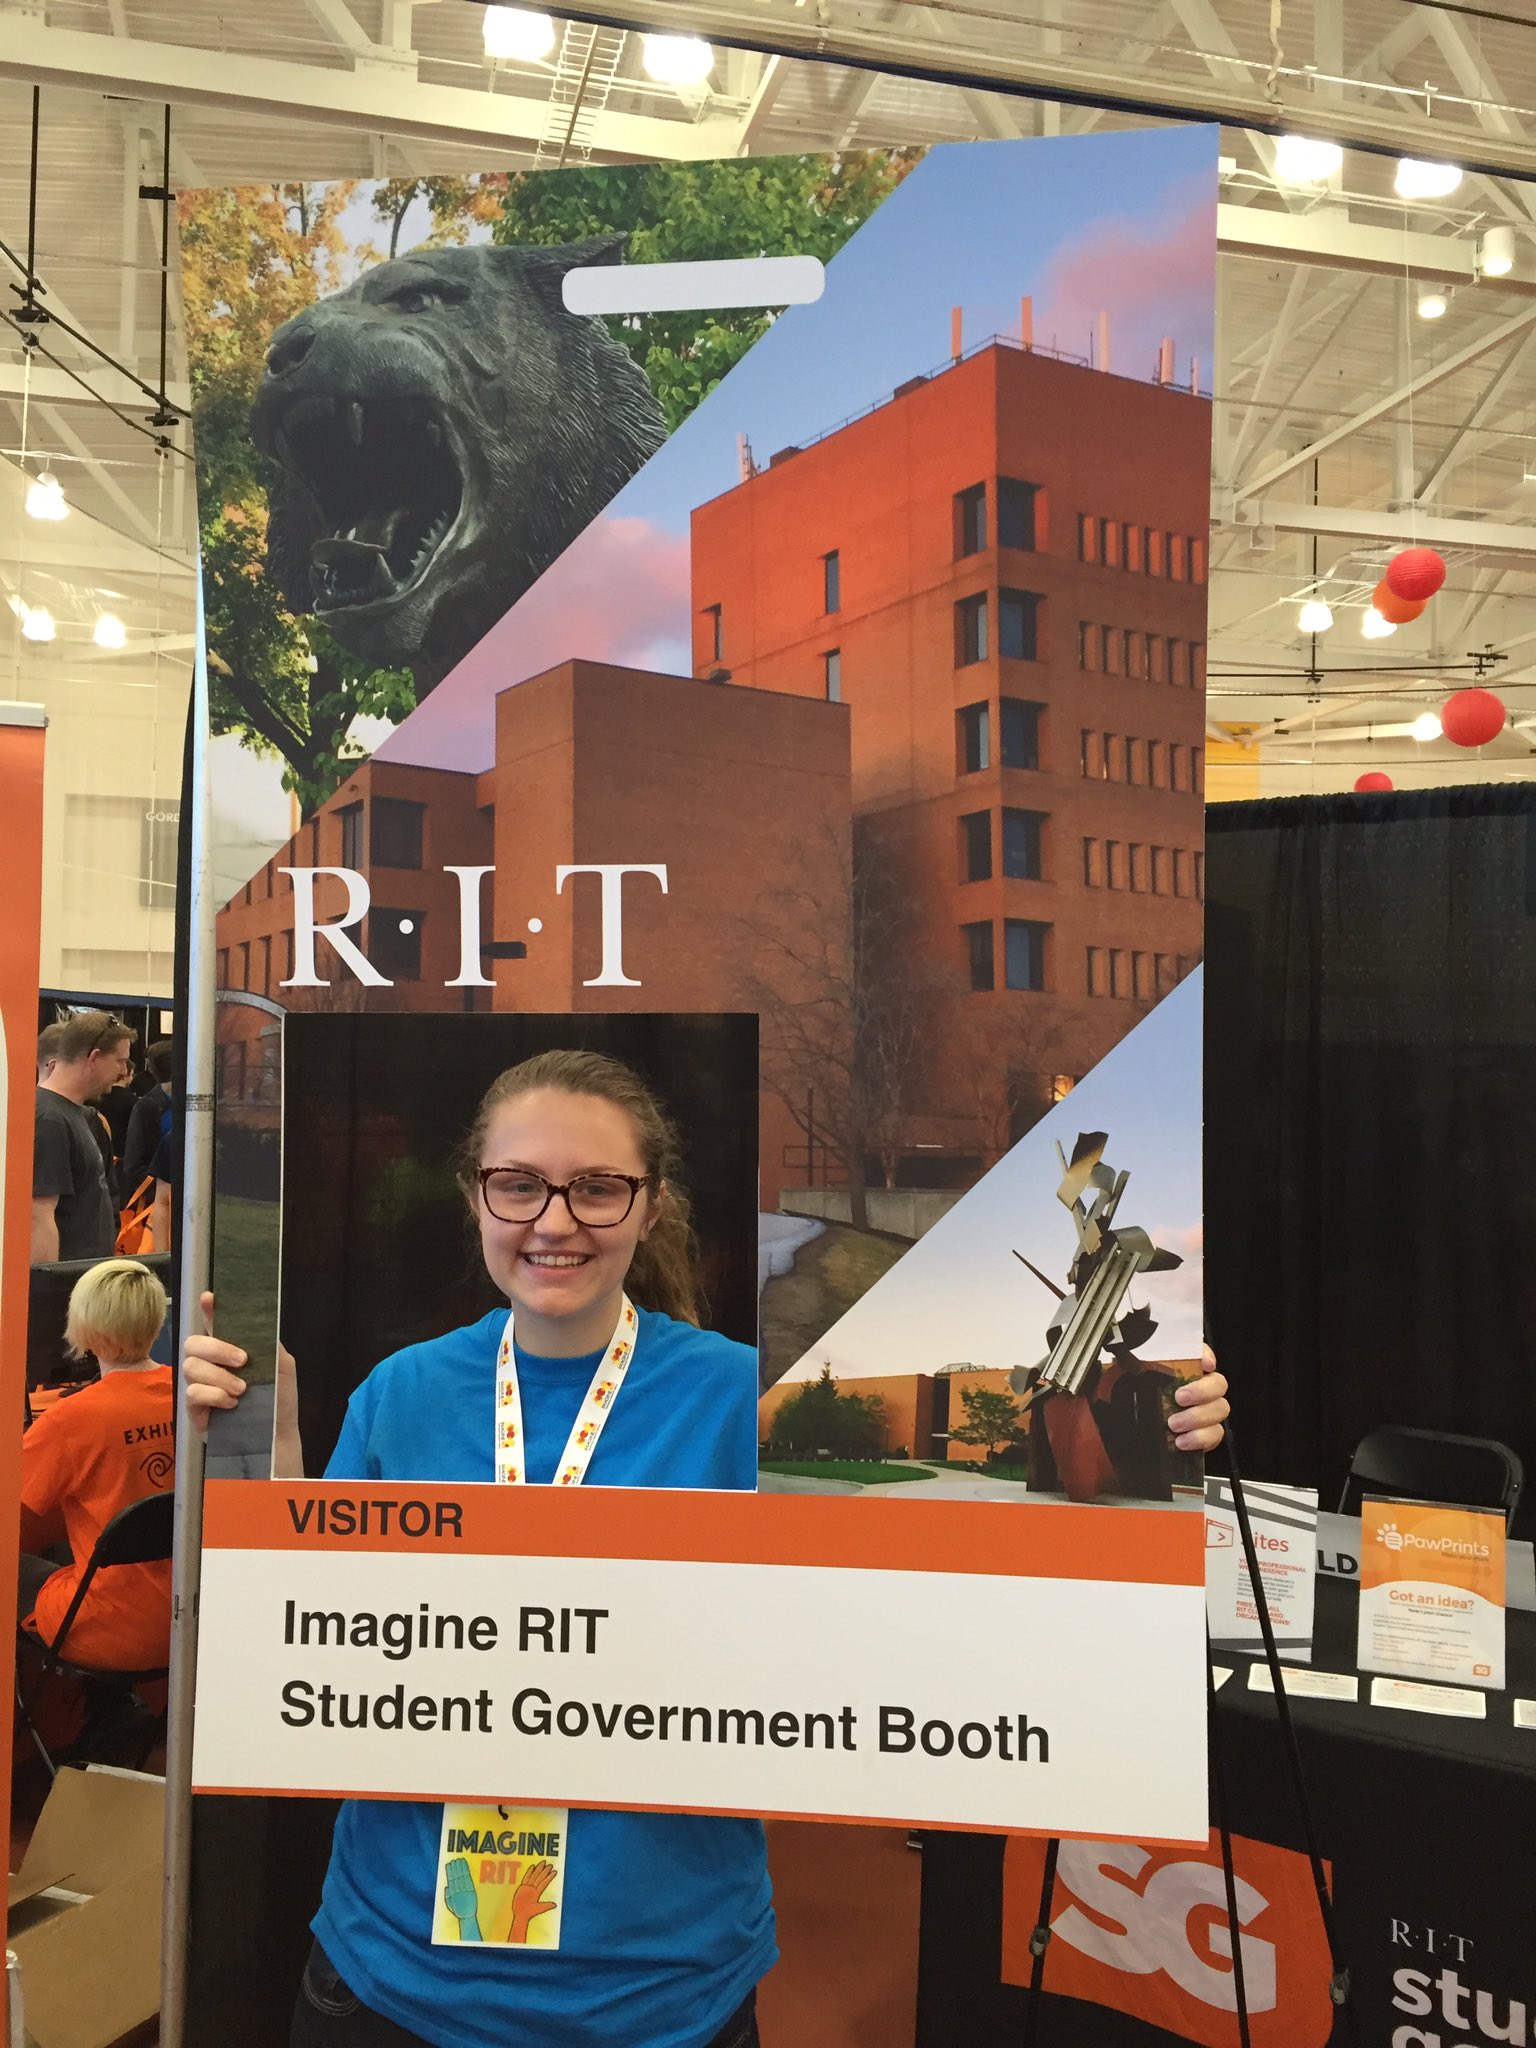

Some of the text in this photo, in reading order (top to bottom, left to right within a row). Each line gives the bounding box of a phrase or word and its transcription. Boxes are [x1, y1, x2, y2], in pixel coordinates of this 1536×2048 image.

[287, 1499, 464, 1538] VISITOR
[1241, 1531, 1290, 1553] ites
[1404, 1533, 1490, 1557] PawPrints
[1317, 1549, 1359, 1575] LD
[1389, 1590, 1414, 1603] Got
[1417, 1595, 1435, 1606] an
[1437, 1595, 1475, 1610] idea?
[284, 1600, 609, 1660] Imagine RIT
[280, 1679, 1049, 1763] Student Government Booth
[446, 1829, 560, 1857] IMAGINE
[479, 1859, 523, 1886] RIT
[1050, 1838, 1277, 2014] SG
[1392, 1968, 1536, 2047] stu
